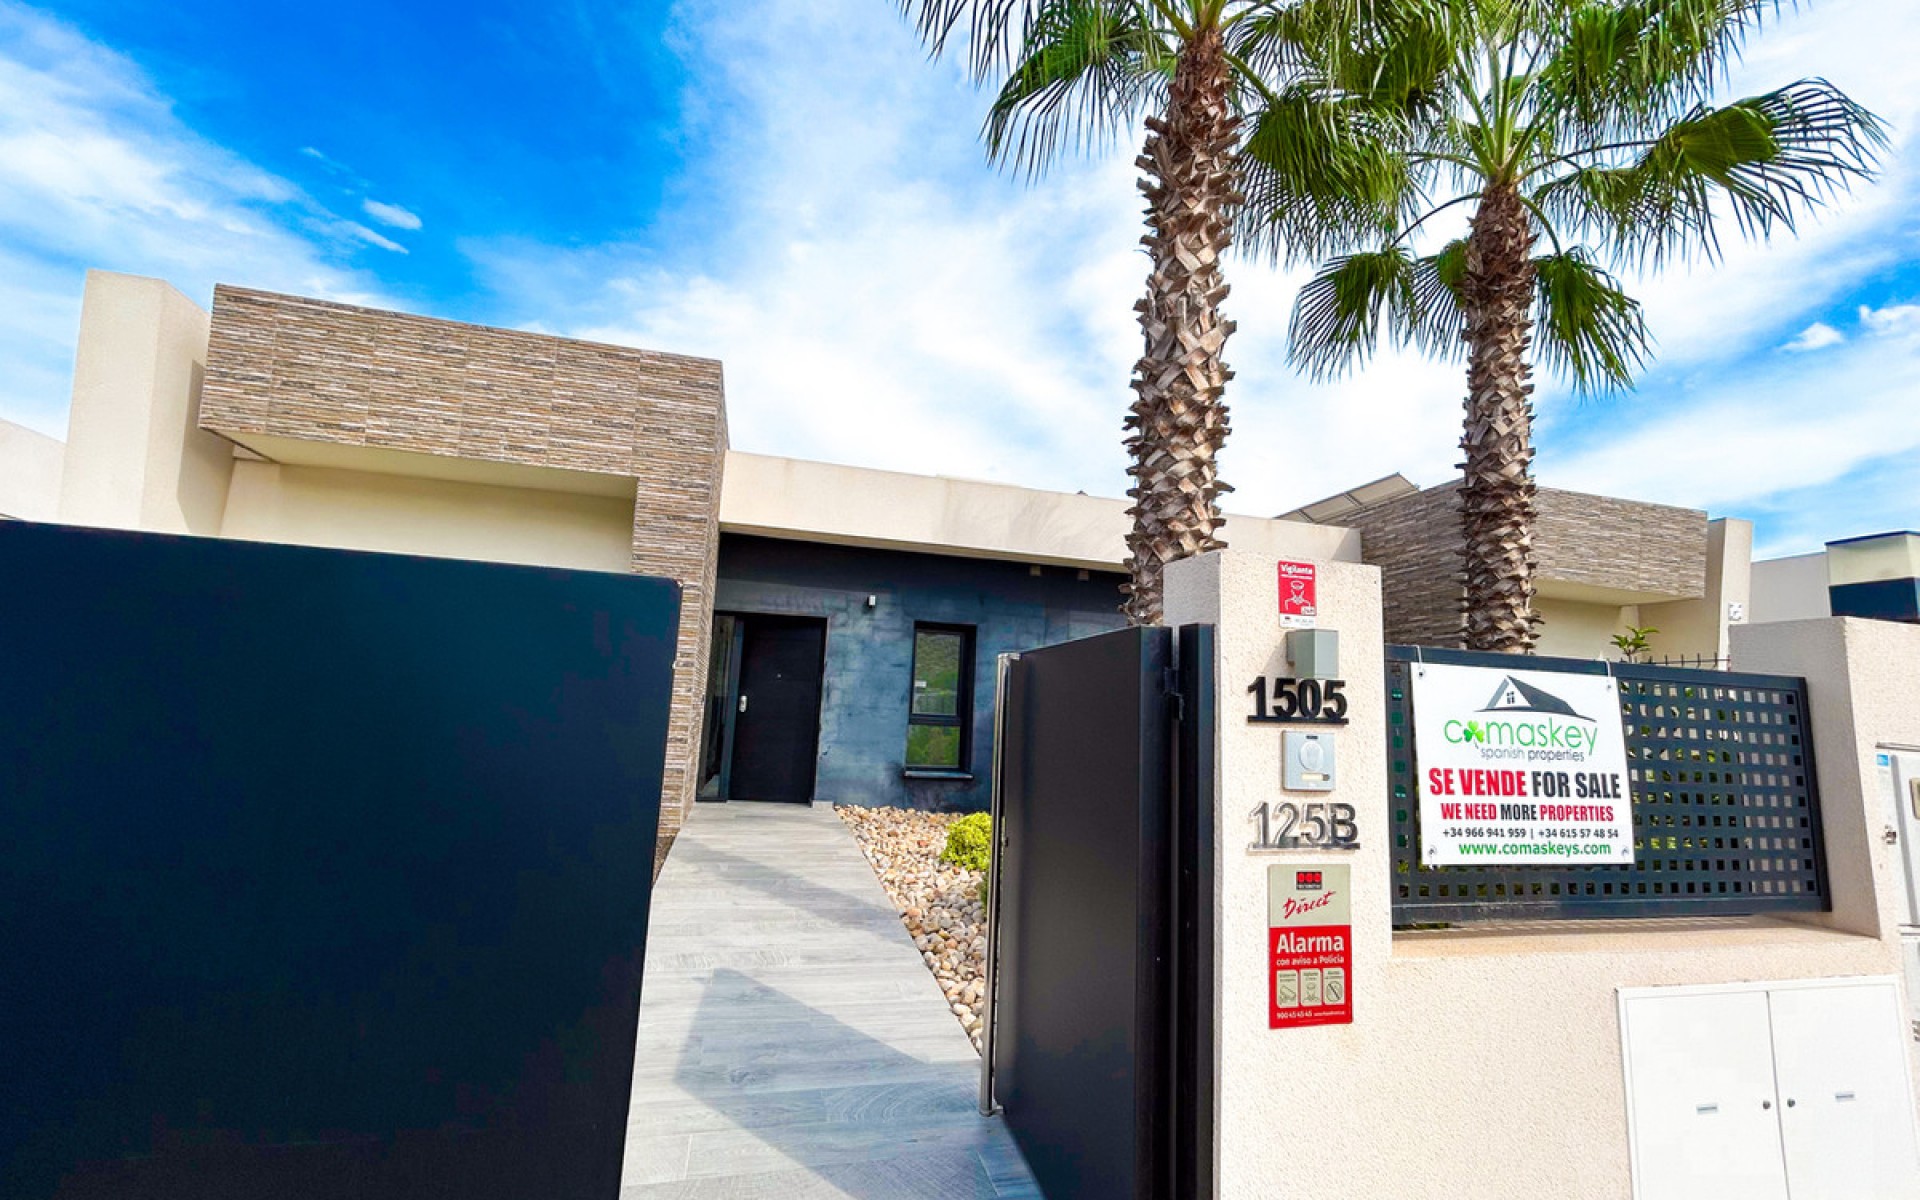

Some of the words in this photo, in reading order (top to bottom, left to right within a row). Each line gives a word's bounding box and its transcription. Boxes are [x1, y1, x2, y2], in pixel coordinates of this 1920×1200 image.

[1248, 676, 1348, 719] 1505
[1480, 747, 1525, 760] spanish
[1527, 748, 1584, 762] properties
[1428, 768, 1455, 796] SE
[1458, 768, 1527, 796] VENDE
[1531, 771, 1570, 798] FOR
[1575, 773, 1621, 799] SALE
[1440, 803, 1462, 819] WE
[1464, 803, 1497, 820] NEED
[1500, 804, 1537, 821] MORE
[1539, 805, 1614, 822] PROPERTIES
[1248, 802, 1358, 846] 125B
[1443, 827, 1463, 837] +34
[1465, 827, 1484, 838] 966
[1486, 827, 1505, 838] 941
[1508, 828, 1526, 838] 959
[1538, 829, 1557, 839] +34
[1560, 829, 1577, 839] 615
[1579, 829, 1591, 839] 57
[1593, 829, 1606, 839] 48
[1607, 829, 1619, 839] 54
[1458, 840, 1612, 858] www.comaskeys.com
[1283, 890, 1336, 919] Direct
[1276, 932, 1344, 954] Alarma
